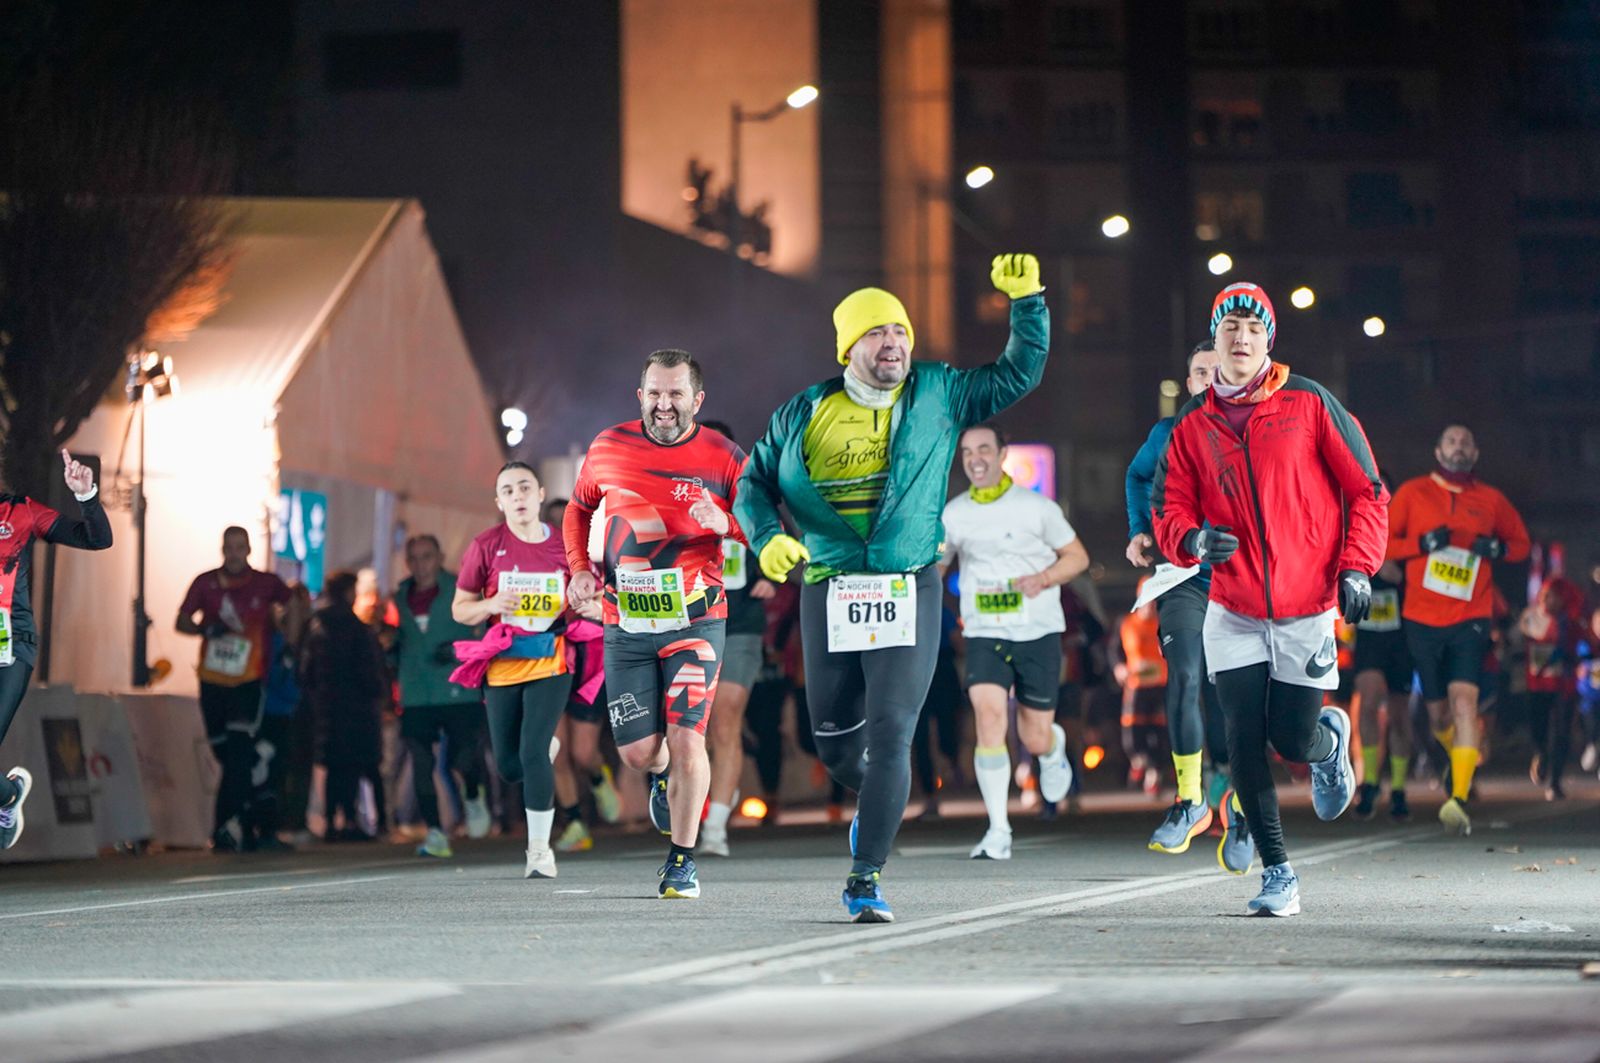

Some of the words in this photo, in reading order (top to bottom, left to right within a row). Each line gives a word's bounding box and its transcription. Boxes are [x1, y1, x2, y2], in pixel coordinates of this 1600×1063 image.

[514, 594, 552, 611] 326
[628, 593, 673, 612] 8009
[848, 601, 896, 624] 6718
